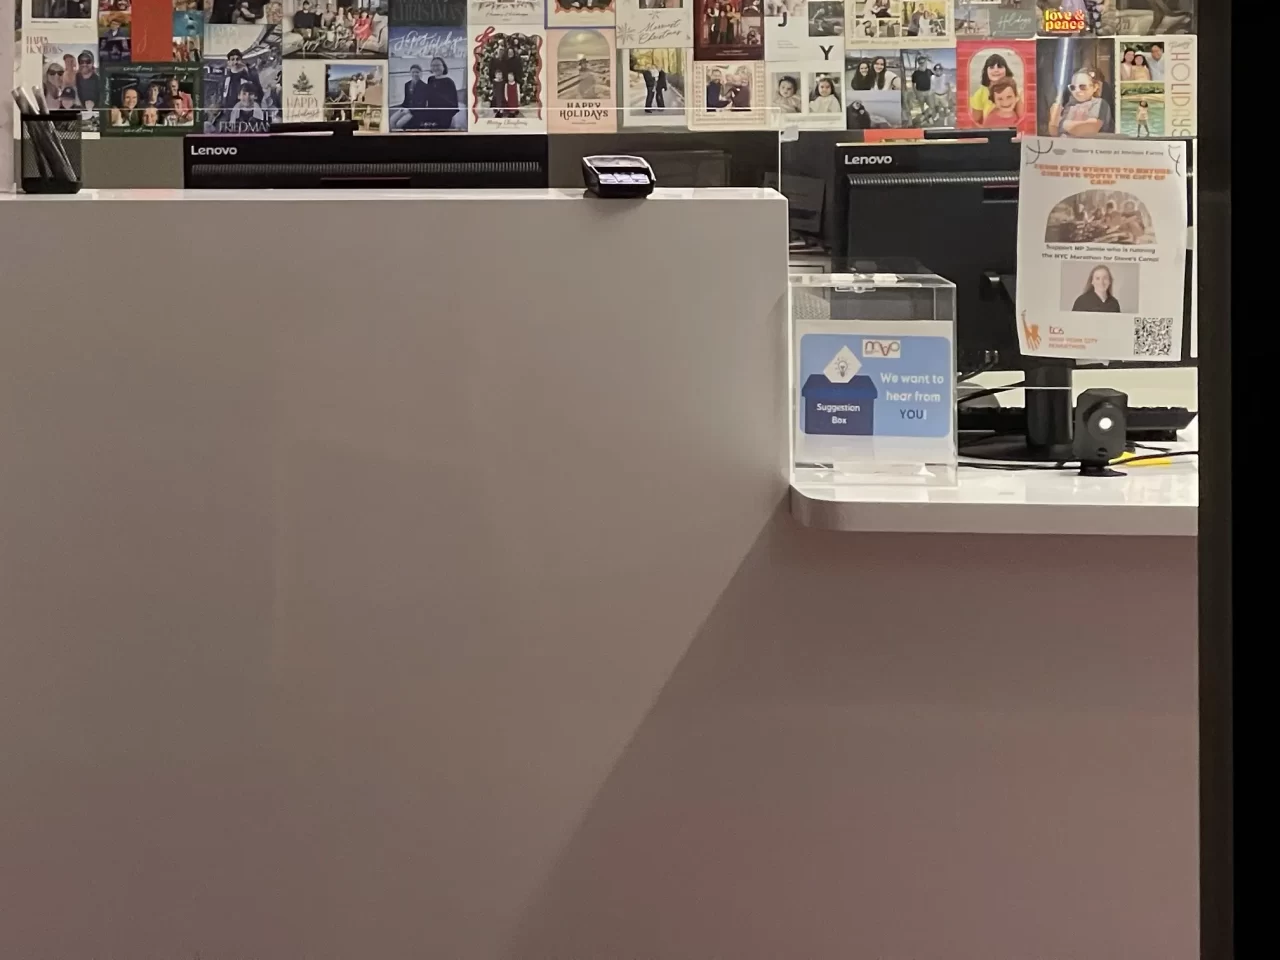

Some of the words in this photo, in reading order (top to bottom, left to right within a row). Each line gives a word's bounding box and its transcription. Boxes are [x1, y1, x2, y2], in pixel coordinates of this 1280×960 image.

[1045, 8, 1073, 21] love
[1075, 8, 1085, 21] &
[1045, 20, 1086, 32] peace
[560, 110, 609, 120] HOLIDAYS
[220, 122, 271, 133] FRIEDMAN
[191, 146, 238, 156] Lenovo
[844, 154, 893, 165] Lenovo
[1046, 244, 1073, 252] Support
[880, 373, 898, 384] We
[901, 374, 930, 384] want
[932, 374, 945, 384] to
[886, 390, 912, 401] hear
[914, 391, 941, 402] from
[817, 403, 861, 413] Suggestion
[832, 416, 847, 424] Box
